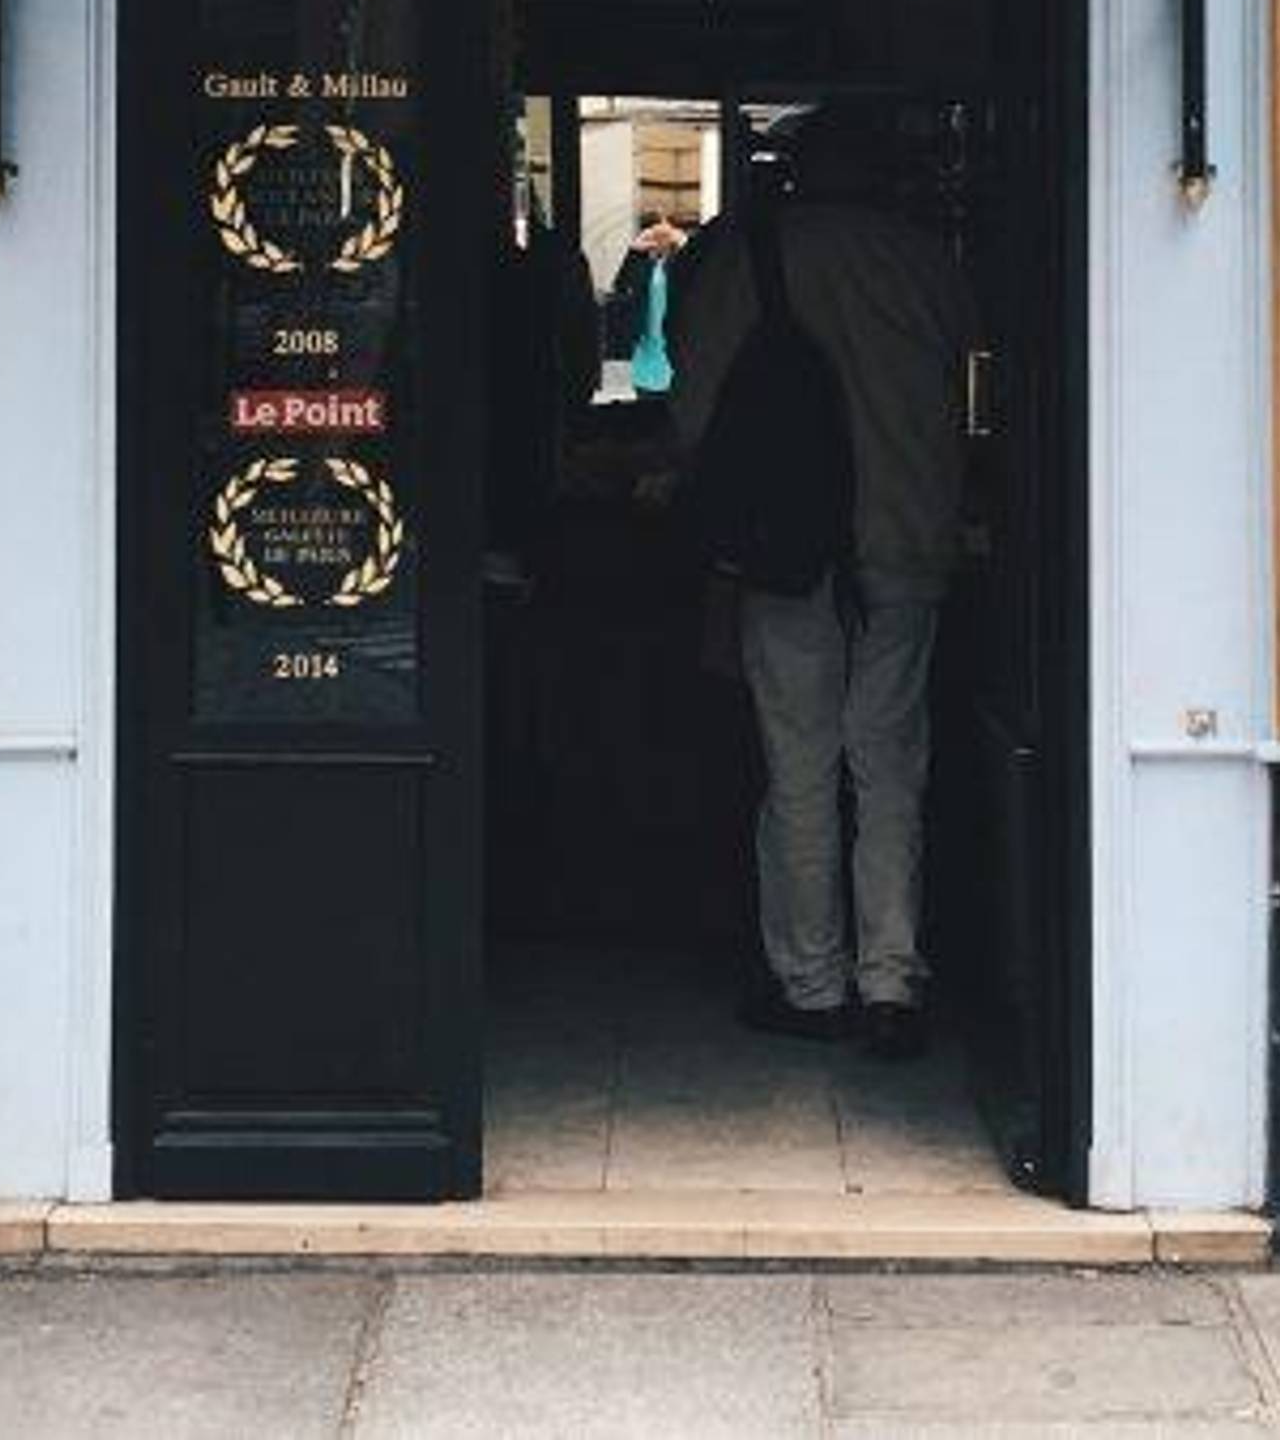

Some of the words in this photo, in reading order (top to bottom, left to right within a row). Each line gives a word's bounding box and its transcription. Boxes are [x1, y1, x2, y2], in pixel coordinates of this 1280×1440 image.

[203, 72, 279, 99] Gault
[286, 73, 313, 98] &
[322, 72, 409, 99] Millau
[272, 329, 340, 354] 2008
[233, 397, 276, 427] Le
[282, 397, 384, 428] Point
[272, 654, 340, 679] 2014
